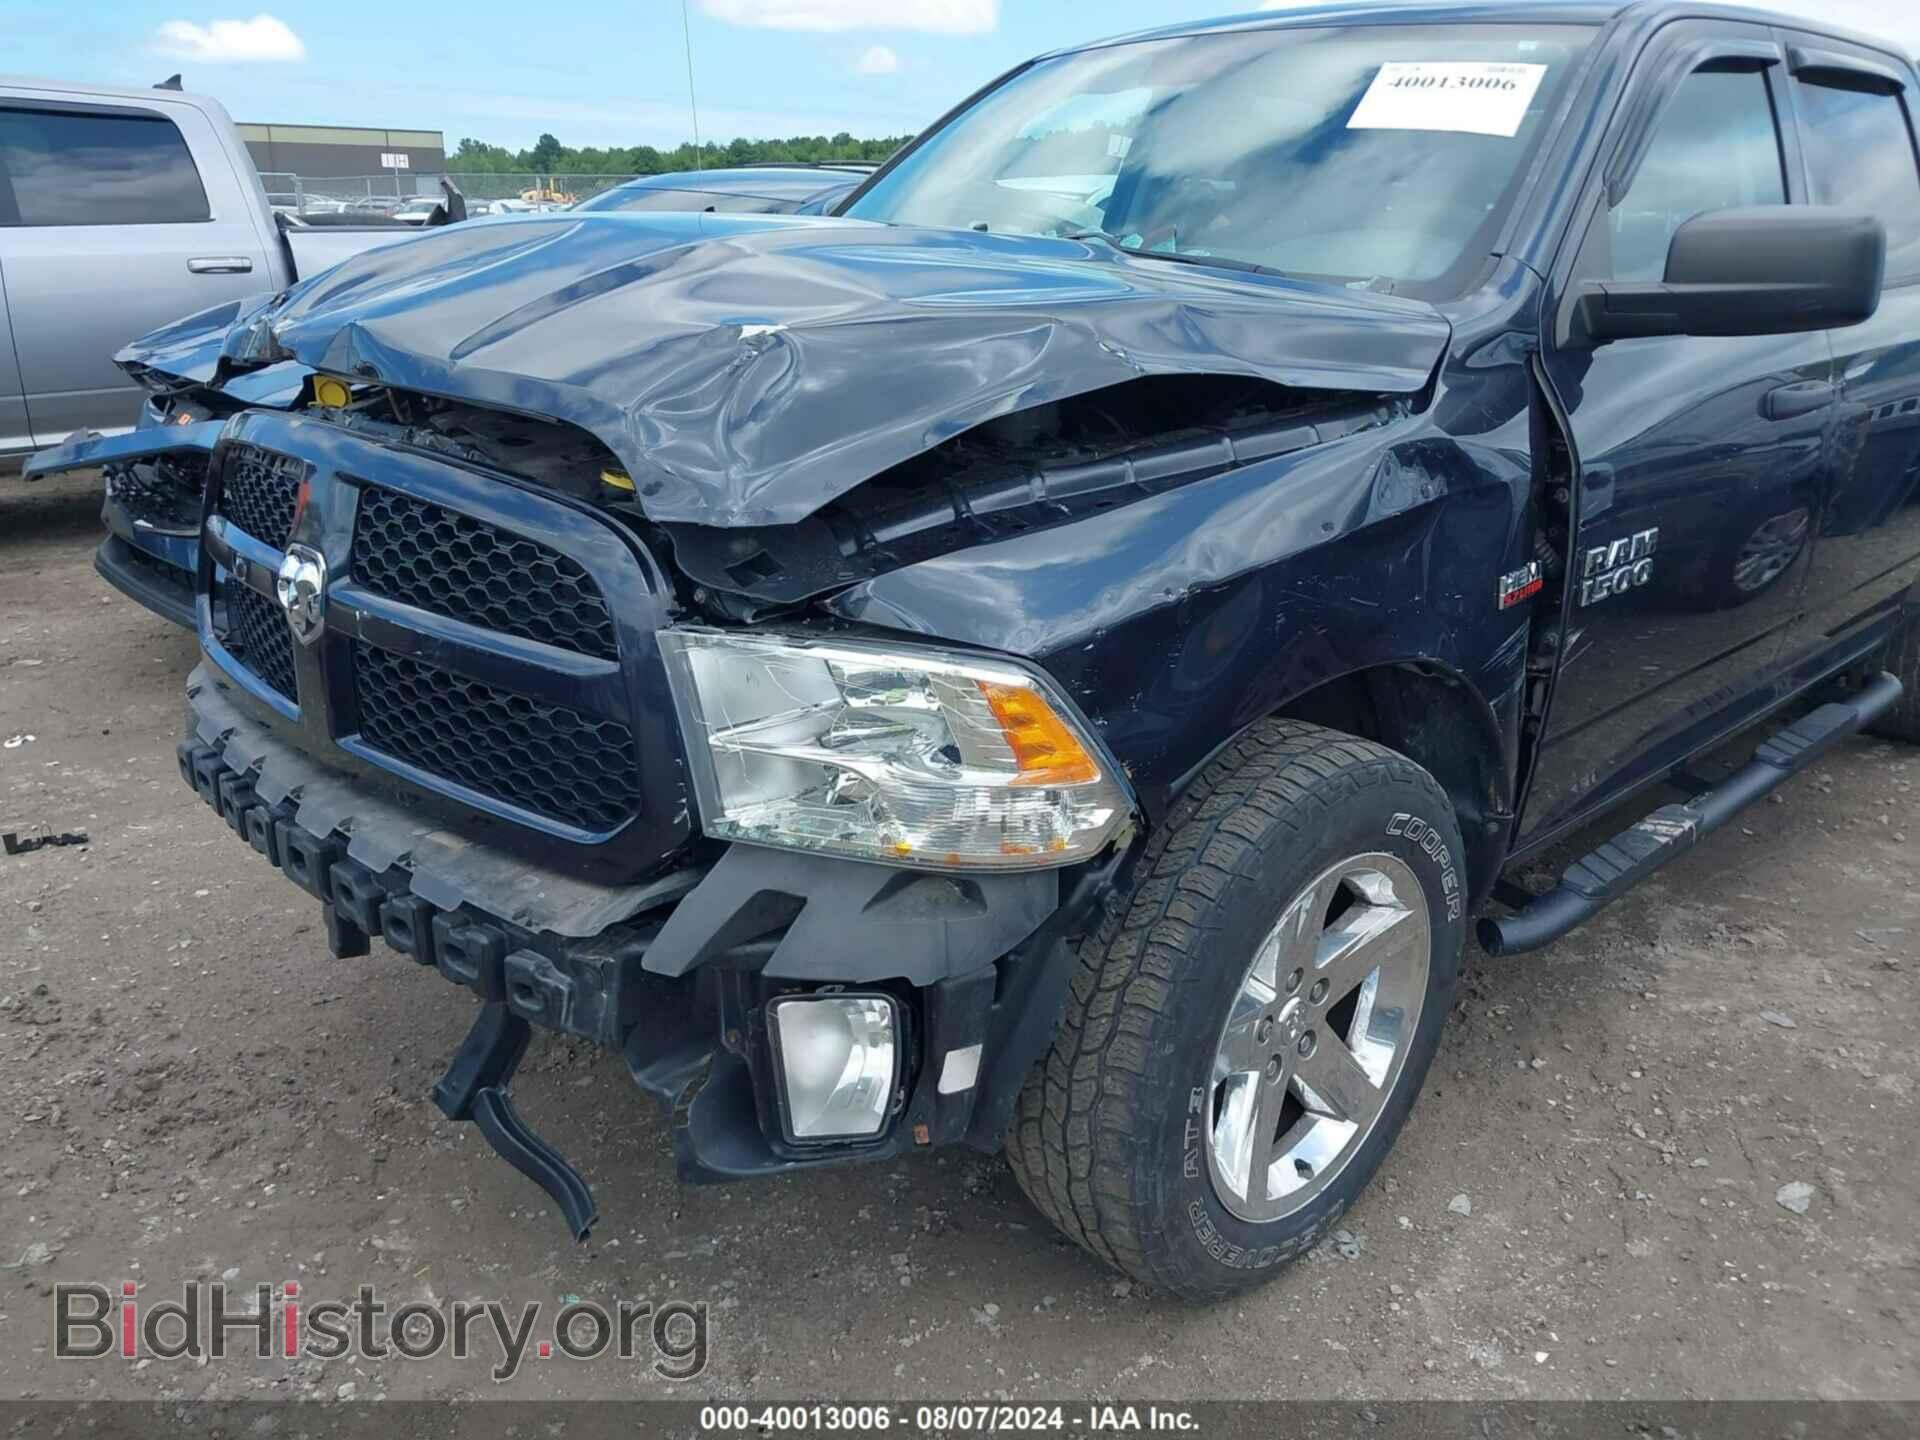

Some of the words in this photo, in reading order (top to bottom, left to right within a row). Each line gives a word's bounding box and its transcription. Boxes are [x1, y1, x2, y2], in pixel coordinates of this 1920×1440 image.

[1387, 74, 1517, 92] 40013006
[1584, 527, 1659, 578] RAM
[1580, 557, 1653, 607] 1500
[1385, 812, 1461, 923] COOPER
